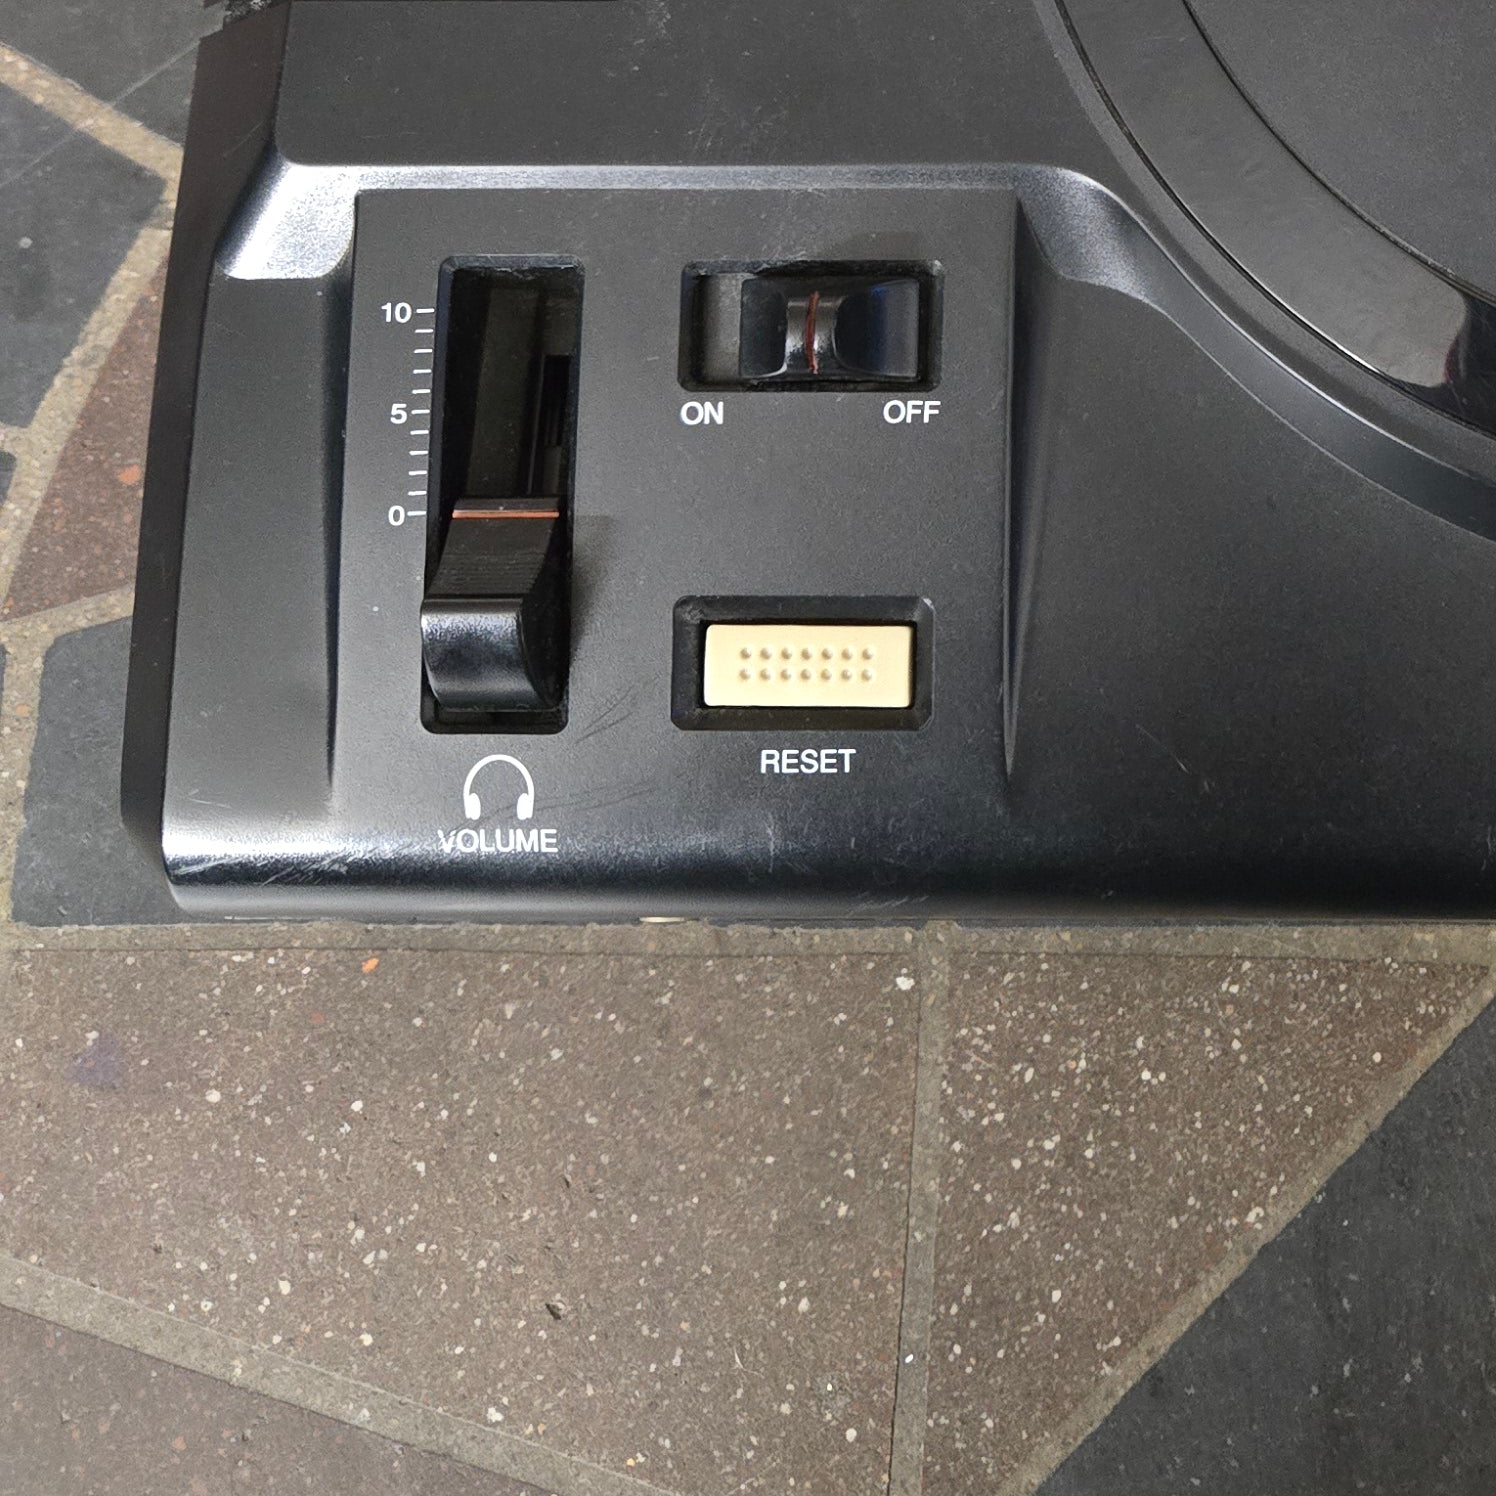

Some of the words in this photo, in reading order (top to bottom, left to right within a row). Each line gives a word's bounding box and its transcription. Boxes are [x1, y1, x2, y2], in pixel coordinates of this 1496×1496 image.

[381, 302, 411, 323] 10
[391, 404, 407, 425] 5
[680, 402, 724, 426] ON
[883, 400, 941, 424] OFF
[388, 505, 406, 526] 0
[760, 749, 856, 774] RESET
[438, 829, 559, 853] VOLUME
